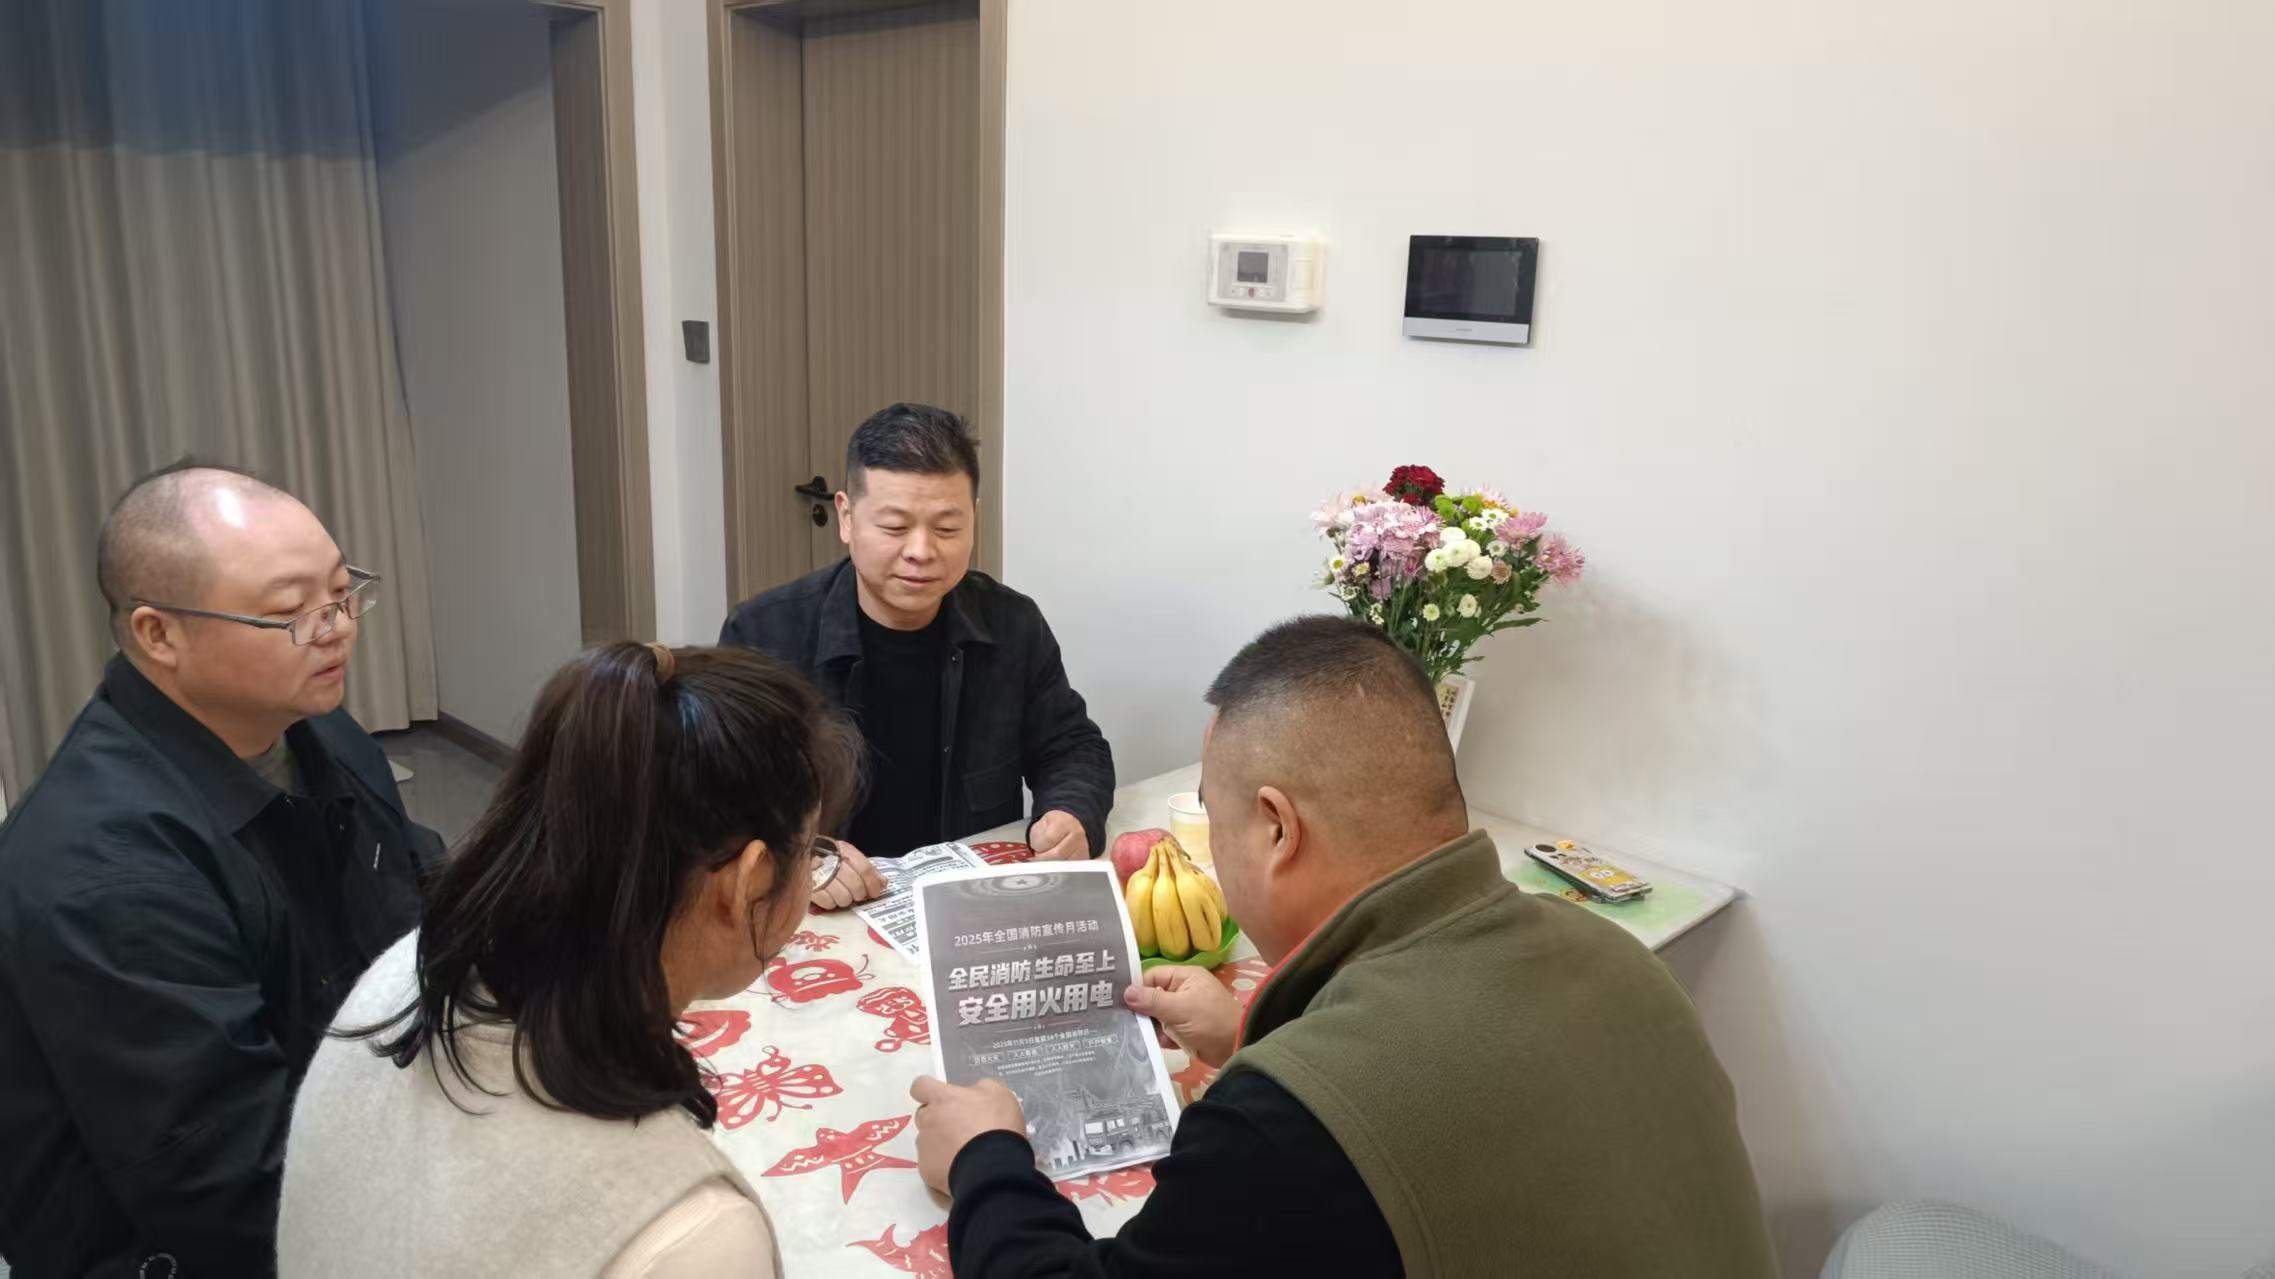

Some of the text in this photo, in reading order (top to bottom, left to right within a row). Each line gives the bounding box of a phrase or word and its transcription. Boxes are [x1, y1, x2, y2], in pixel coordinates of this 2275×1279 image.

[954, 919, 1099, 947] 2025年全国消防宣传月活动
[948, 949, 1116, 991] 全民消防 生命至上
[958, 980, 1114, 1027] 安全用火用电
